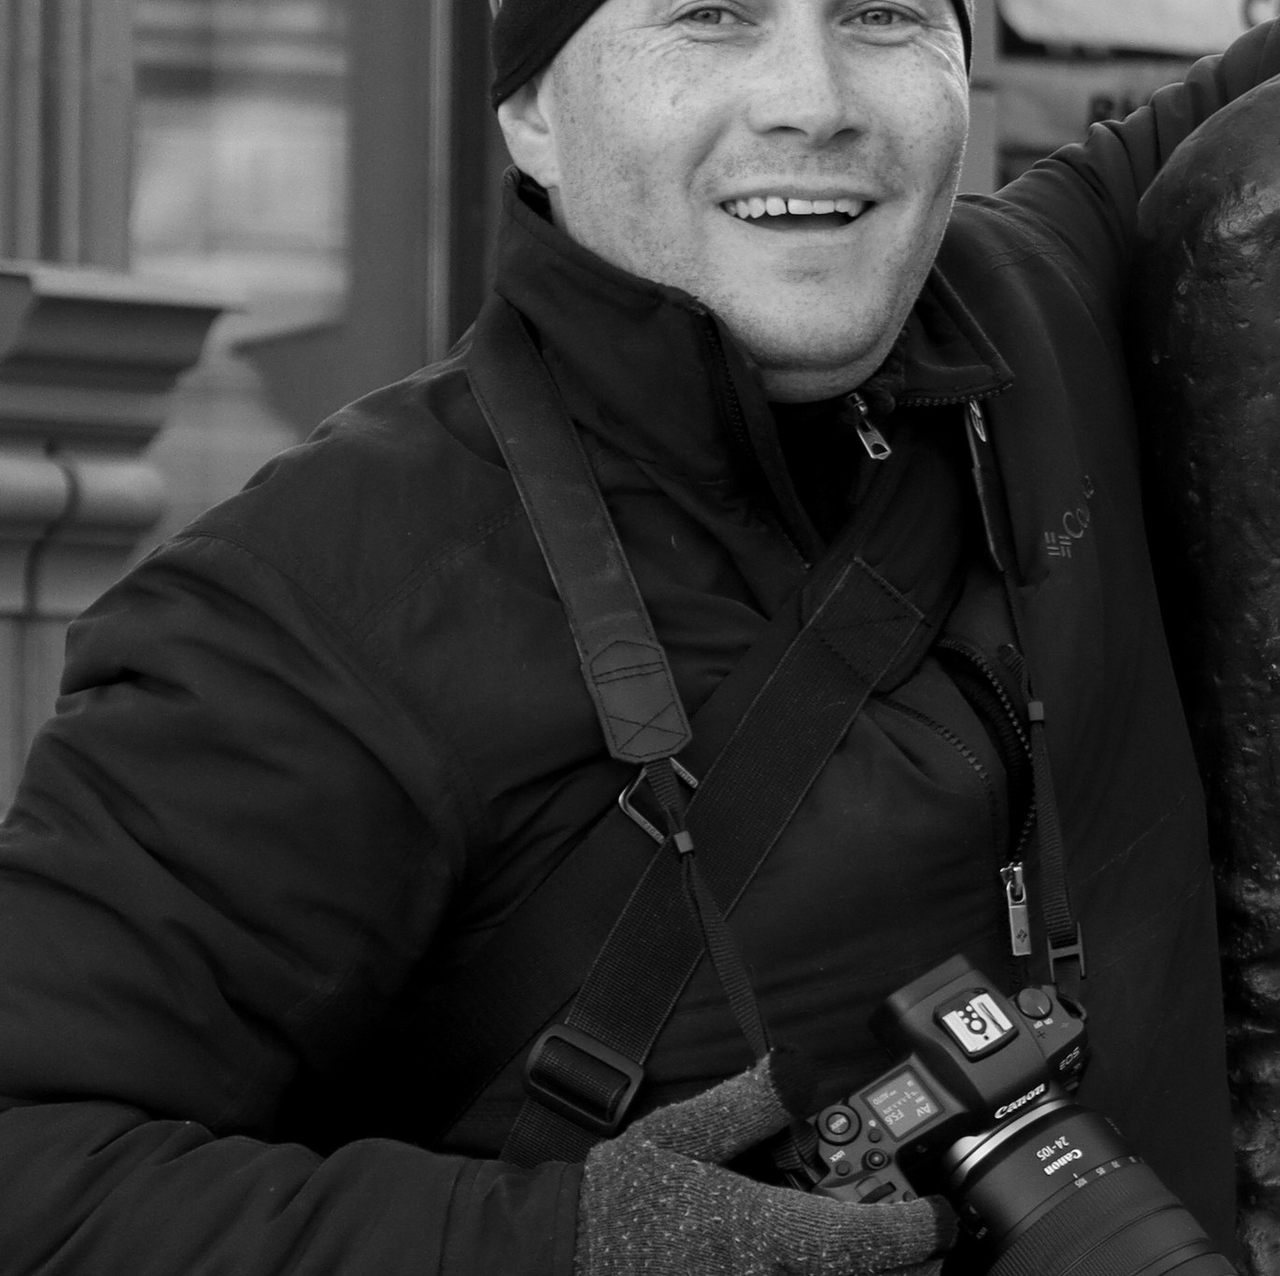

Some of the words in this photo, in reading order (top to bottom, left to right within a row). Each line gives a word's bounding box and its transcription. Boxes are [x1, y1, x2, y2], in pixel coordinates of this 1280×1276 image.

[1059, 1046, 1080, 1071] EOS
[994, 1083, 1046, 1120] Canon
[1036, 1136, 1070, 1162] 24-105
[1043, 1148, 1083, 1176] Canon
